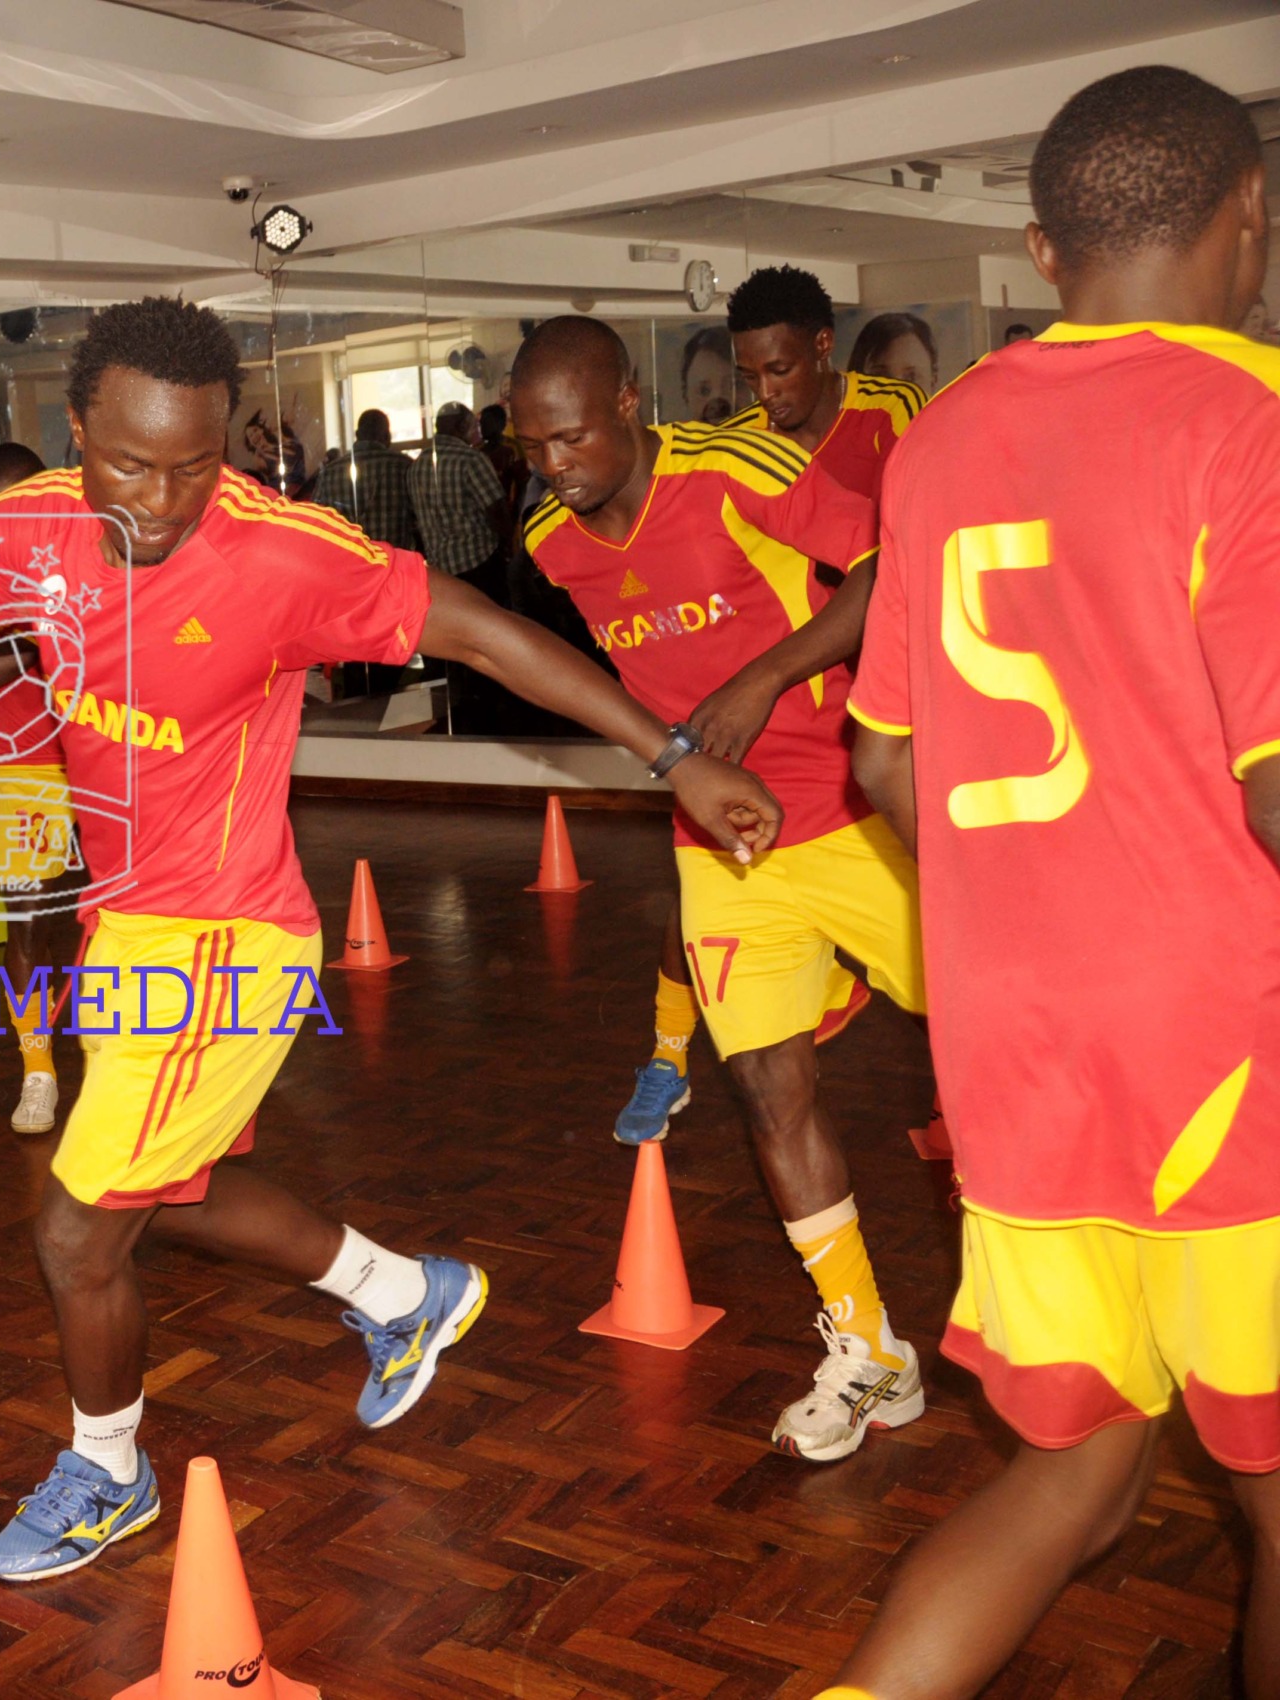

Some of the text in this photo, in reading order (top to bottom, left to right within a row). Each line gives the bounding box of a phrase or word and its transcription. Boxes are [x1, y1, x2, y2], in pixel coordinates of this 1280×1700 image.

[940, 517, 1090, 830] 5
[685, 936, 741, 1008] 17
[194, 1669, 227, 1681] PRO
